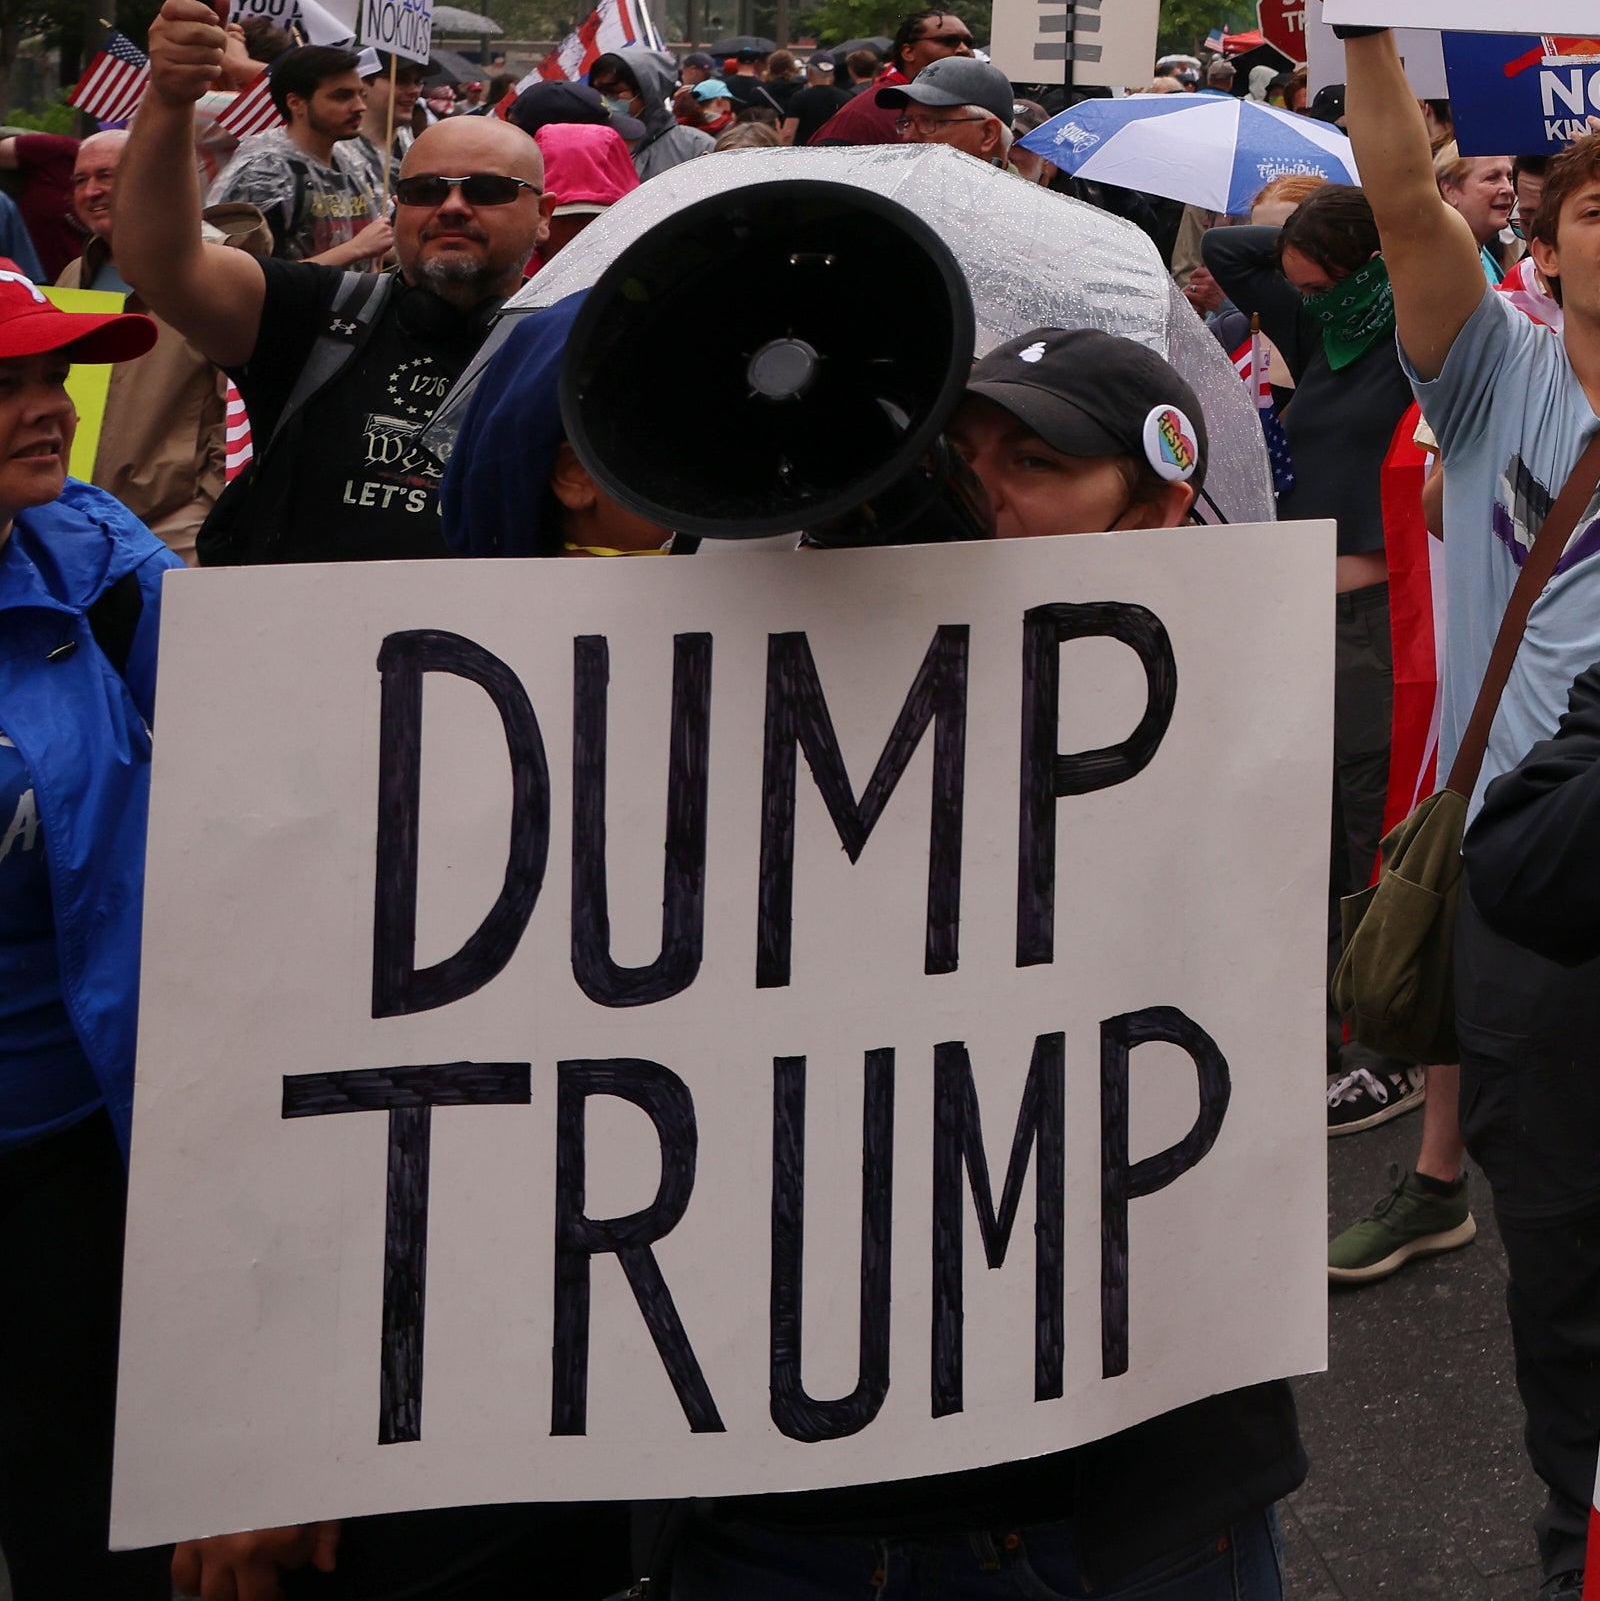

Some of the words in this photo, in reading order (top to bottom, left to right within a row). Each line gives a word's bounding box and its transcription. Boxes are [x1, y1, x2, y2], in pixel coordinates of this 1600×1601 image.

[395, 4, 429, 57] KINGS
[409, 374, 449, 398] 1776
[1157, 409, 1194, 472] RESIST
[343, 479, 427, 513] LET'S
[372, 601, 1177, 1019] DUMP
[282, 1005, 1233, 1446] TRUMP
